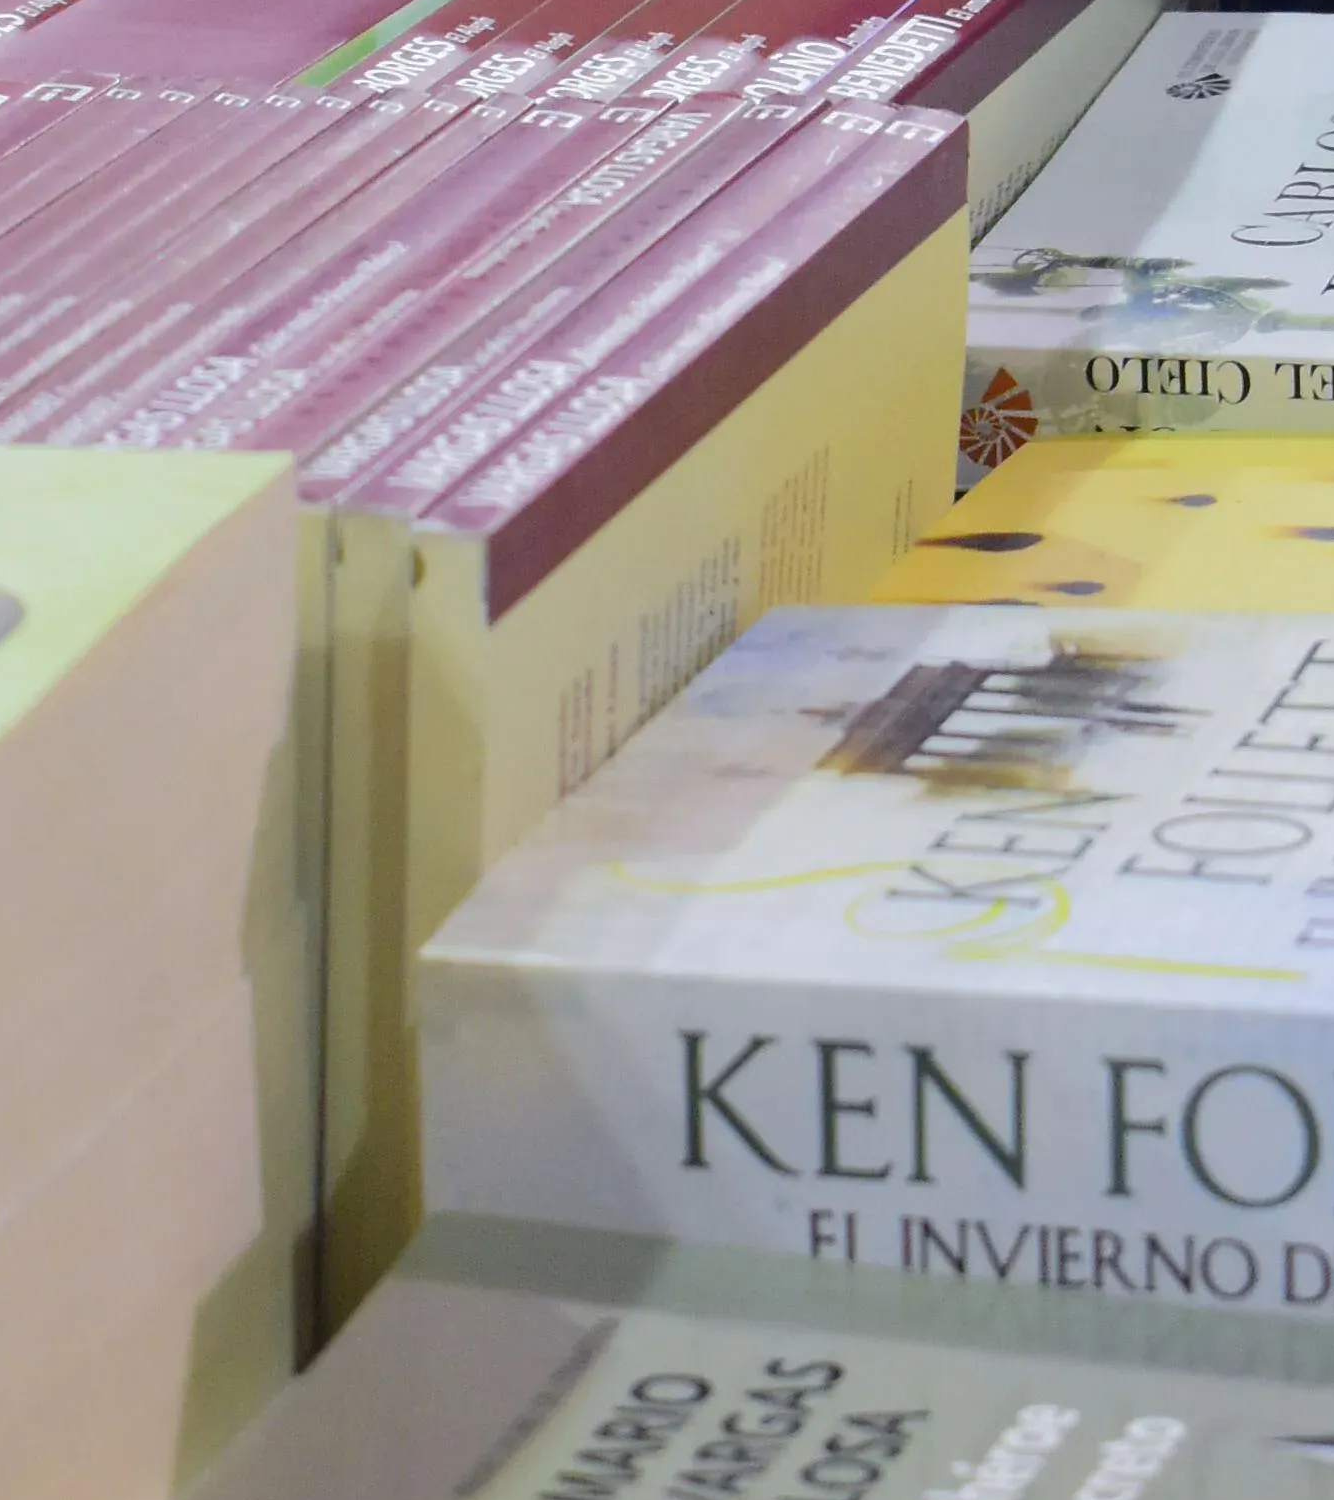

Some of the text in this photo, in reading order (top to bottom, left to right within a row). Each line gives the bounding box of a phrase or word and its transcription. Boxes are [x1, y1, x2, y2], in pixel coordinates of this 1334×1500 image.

[455, 52, 535, 100] RGES
[545, 52, 637, 101] ORGES
[742, 38, 849, 105] OLAÑO
[826, 13, 964, 100] BENEDETTI
[1083, 350, 1252, 406] CIELO
[886, 792, 1139, 911] KEN
[673, 1028, 1035, 1202] KEN
[903, 1216, 1262, 1303] INVIERNO
